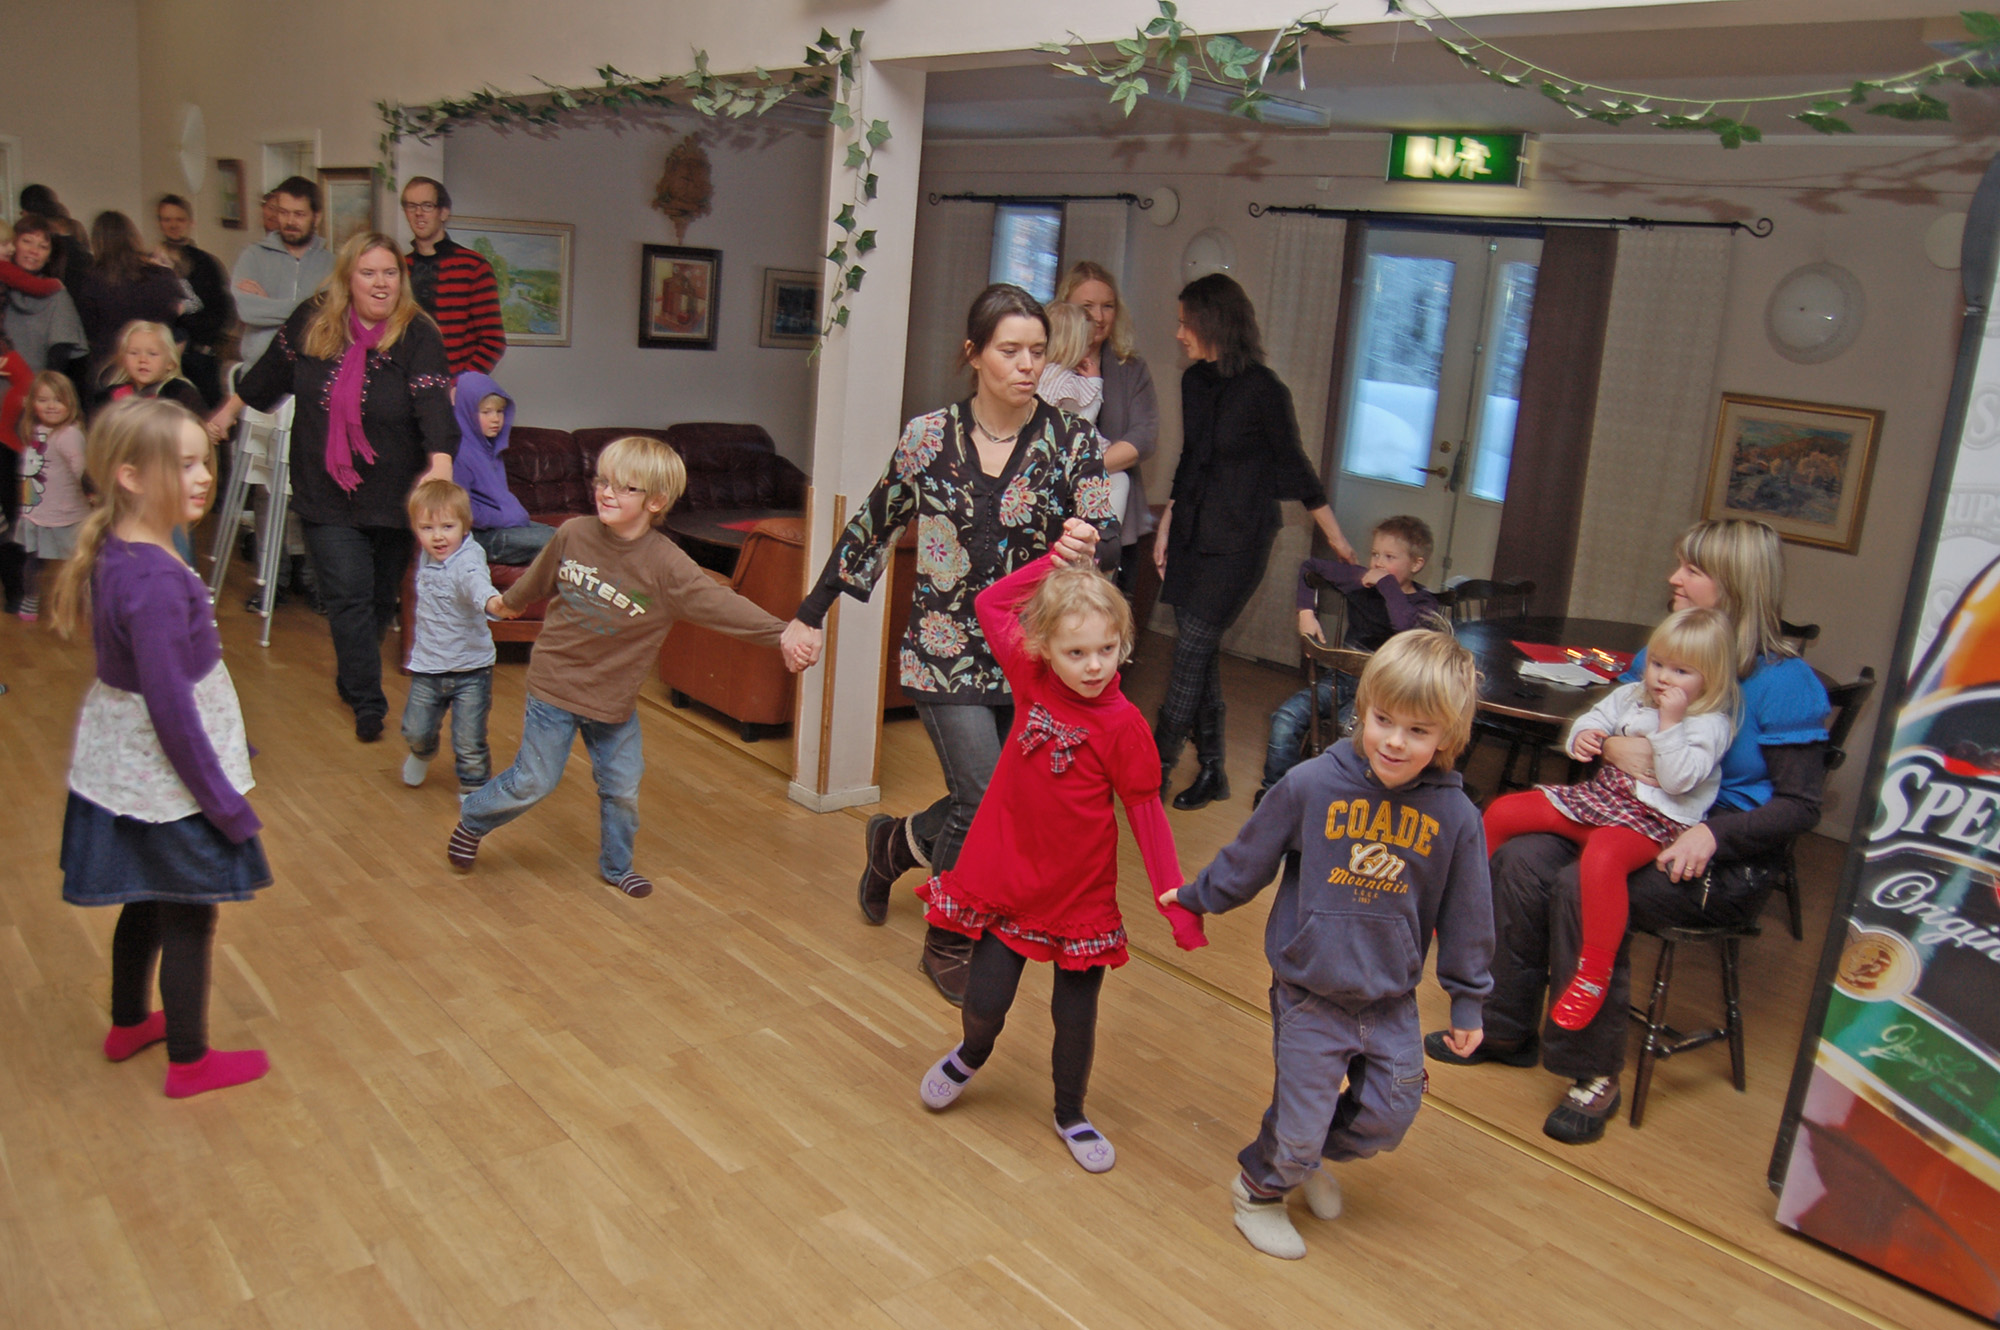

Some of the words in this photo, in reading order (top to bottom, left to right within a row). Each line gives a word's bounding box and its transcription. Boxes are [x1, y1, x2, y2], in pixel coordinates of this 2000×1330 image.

[1325, 799, 1440, 857] COADE
[1869, 764, 2000, 853] SPE
[1327, 866, 1409, 894] Mountain
